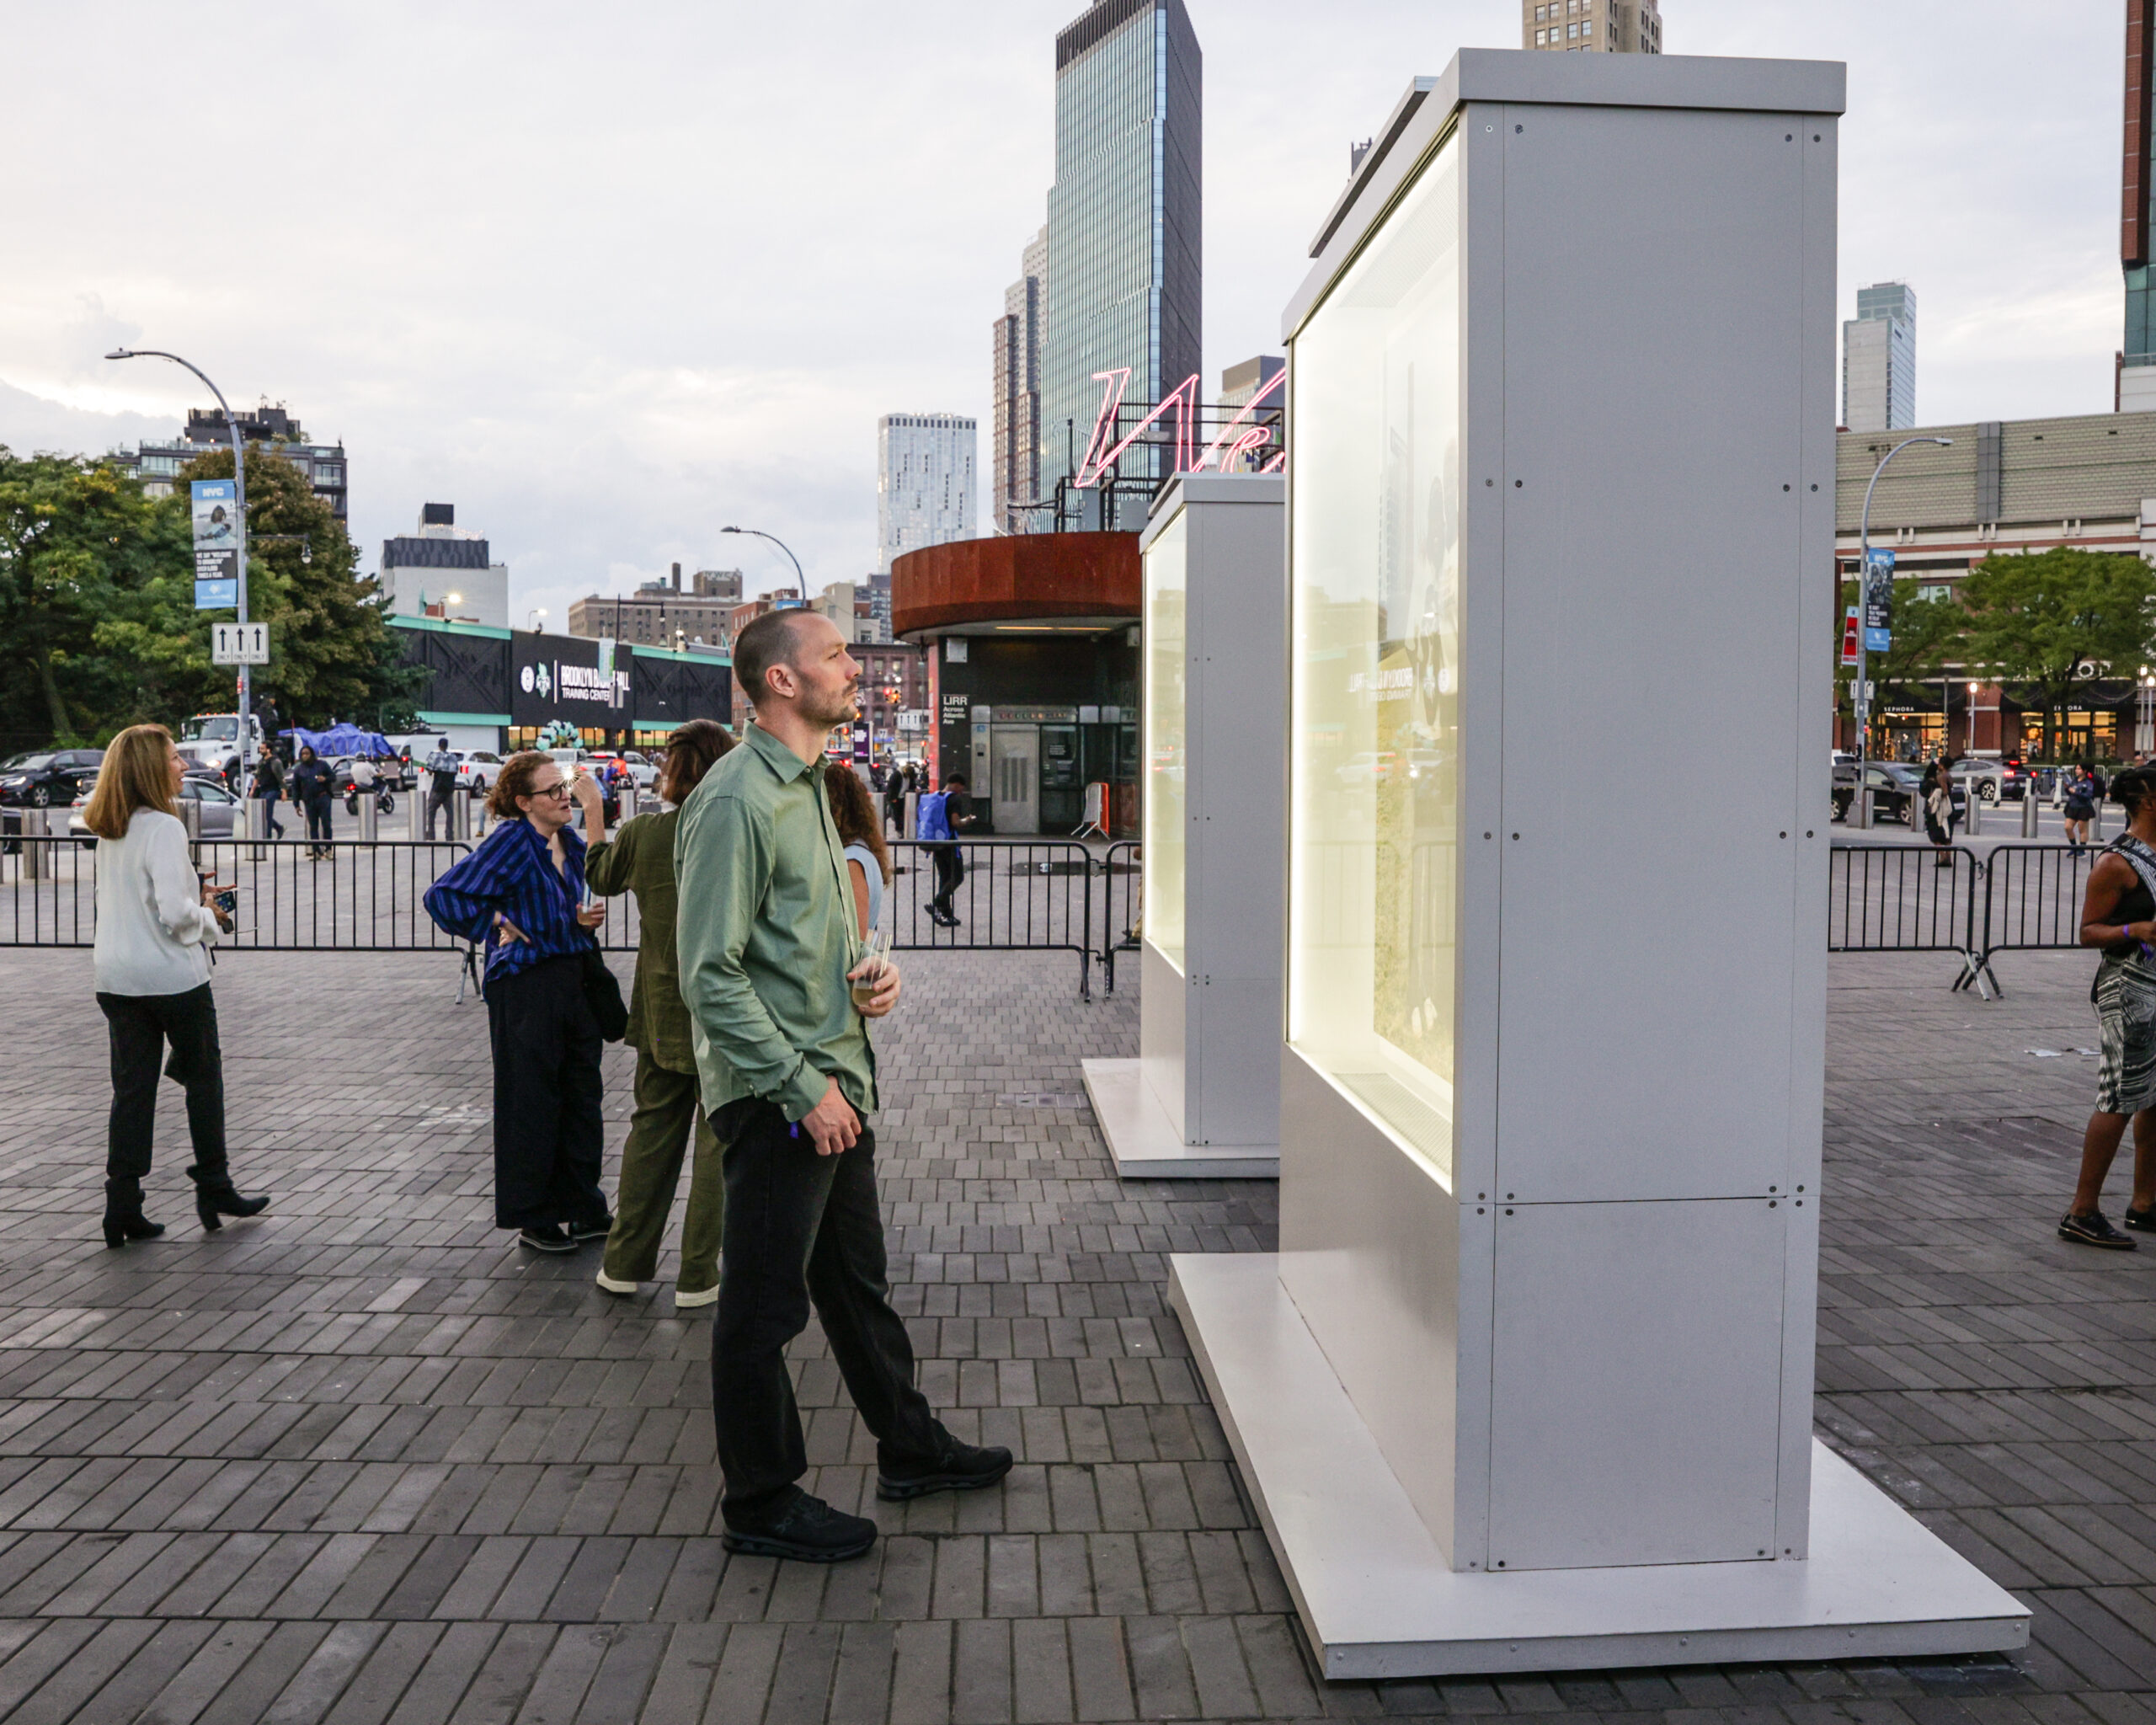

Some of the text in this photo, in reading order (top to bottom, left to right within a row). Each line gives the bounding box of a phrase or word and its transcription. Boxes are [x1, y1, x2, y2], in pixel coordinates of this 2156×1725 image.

[202, 487, 224, 497] NYC
[561, 665, 593, 688] BROOKLYN
[562, 687, 611, 701] TRAINING CENTE
[943, 696, 969, 706] LIRR
